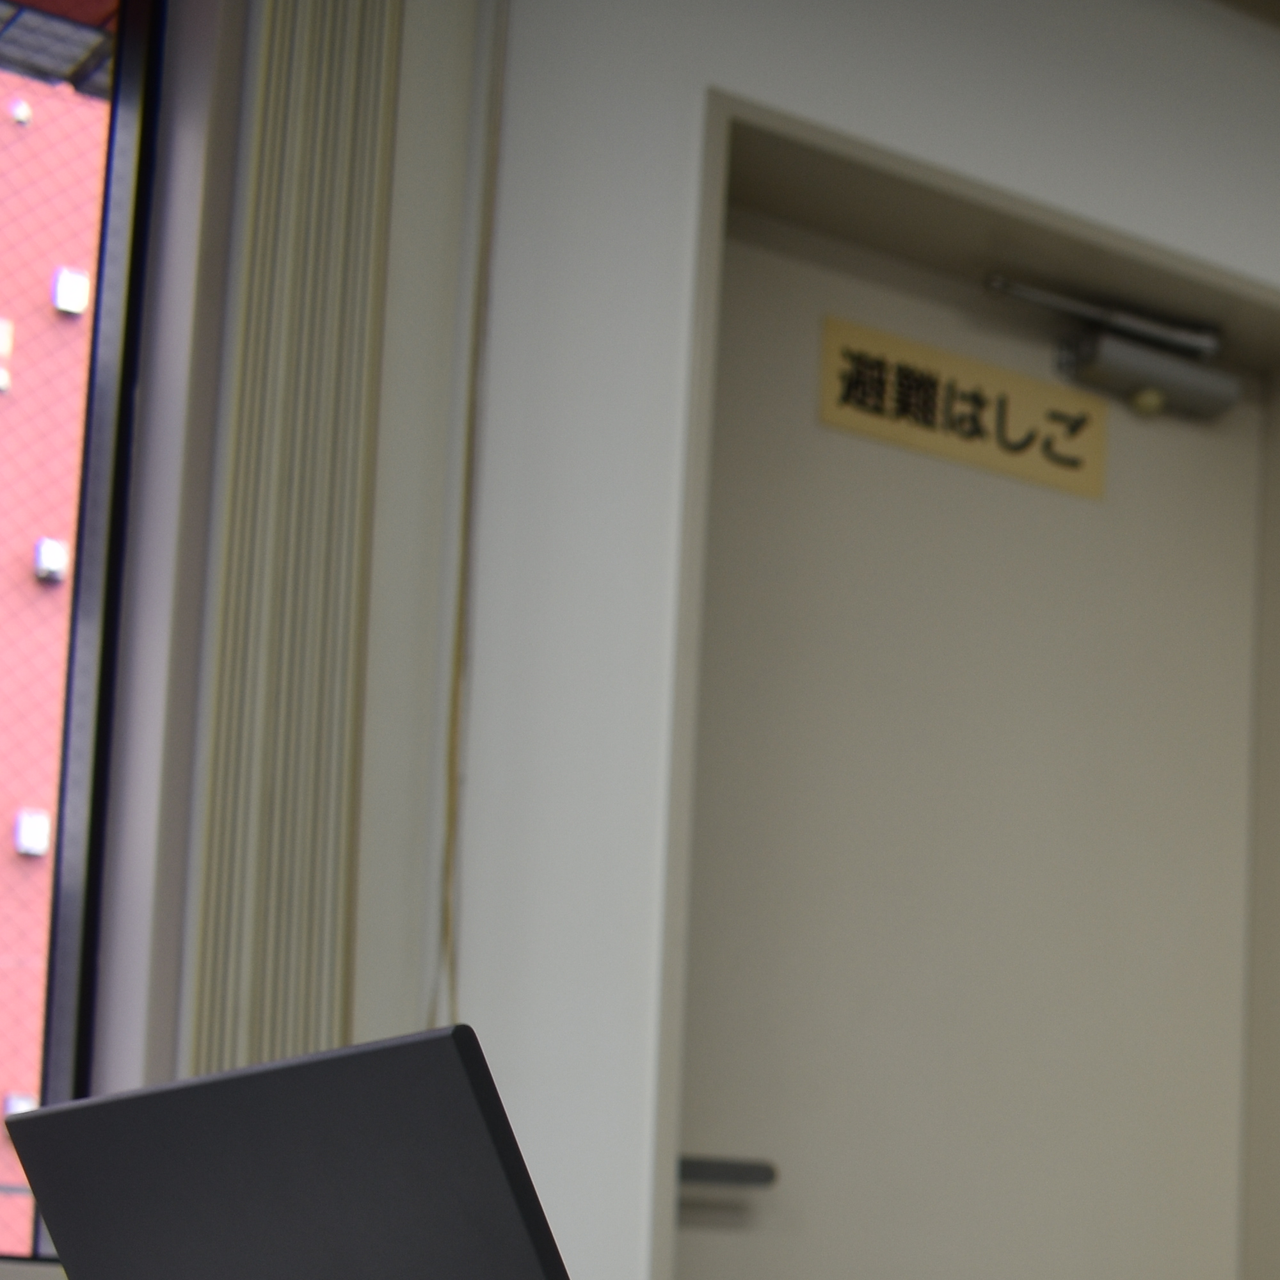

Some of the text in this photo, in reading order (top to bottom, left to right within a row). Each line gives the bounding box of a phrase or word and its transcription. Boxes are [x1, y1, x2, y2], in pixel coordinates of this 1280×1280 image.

[837, 345, 1092, 469] 避難はしご
